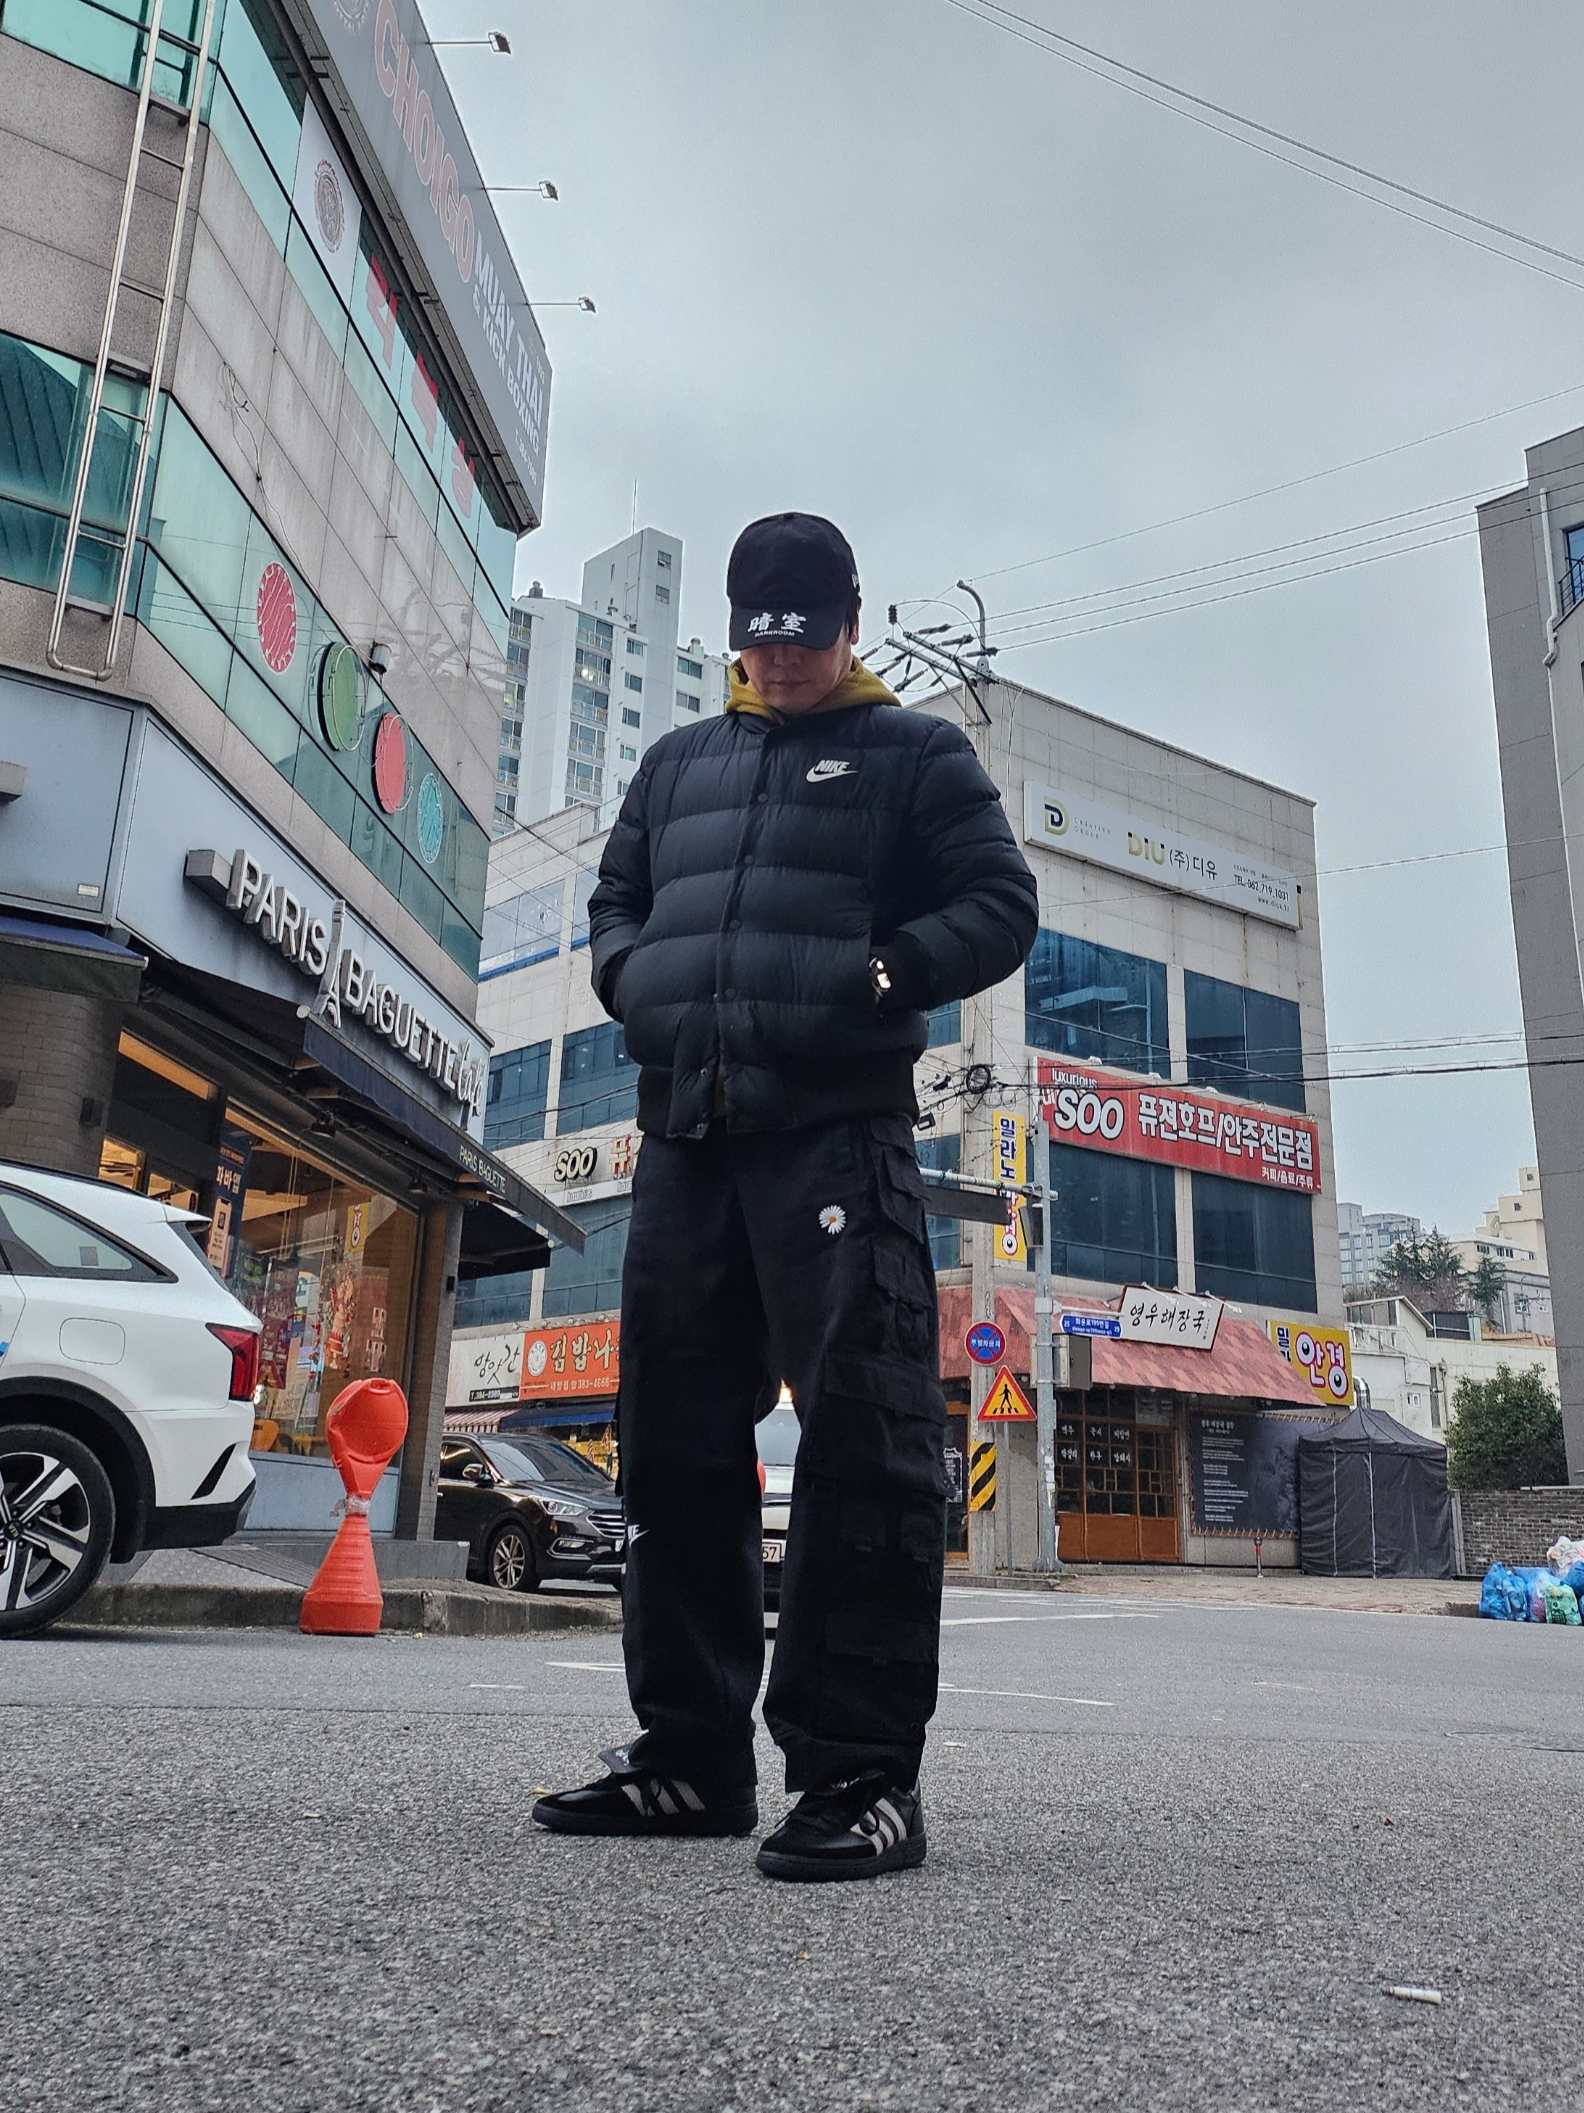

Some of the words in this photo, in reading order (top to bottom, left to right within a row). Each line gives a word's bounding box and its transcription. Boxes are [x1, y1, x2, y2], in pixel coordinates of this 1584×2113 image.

[374, 0, 475, 283] CHOIGO
[474, 230, 515, 354] MUAY
[516, 331, 543, 431] THAI
[472, 283, 481, 319] &
[482, 305, 506, 378] KICK
[506, 364, 540, 458] BOXING
[747, 611, 807, 634] 暗室
[754, 629, 796, 638] DARKROOM
[814, 759, 851, 774] NIKE
[226, 849, 328, 976] PARIS
[343, 949, 458, 1091] BAGUETTE
[1051, 1067, 1099, 1090] luxurious
[1054, 1088, 1125, 1141] SOO
[459, 1145, 478, 1172] PARIS
[478, 1159, 507, 1194] BAGUETTE
[554, 1147, 598, 1182] SOO
[999, 1117, 1017, 1180] 밀라노
[1130, 1302, 1206, 1334] 영우해장국
[550, 1328, 620, 1374] 김밥나
[1295, 1331, 1349, 1399] 안경
